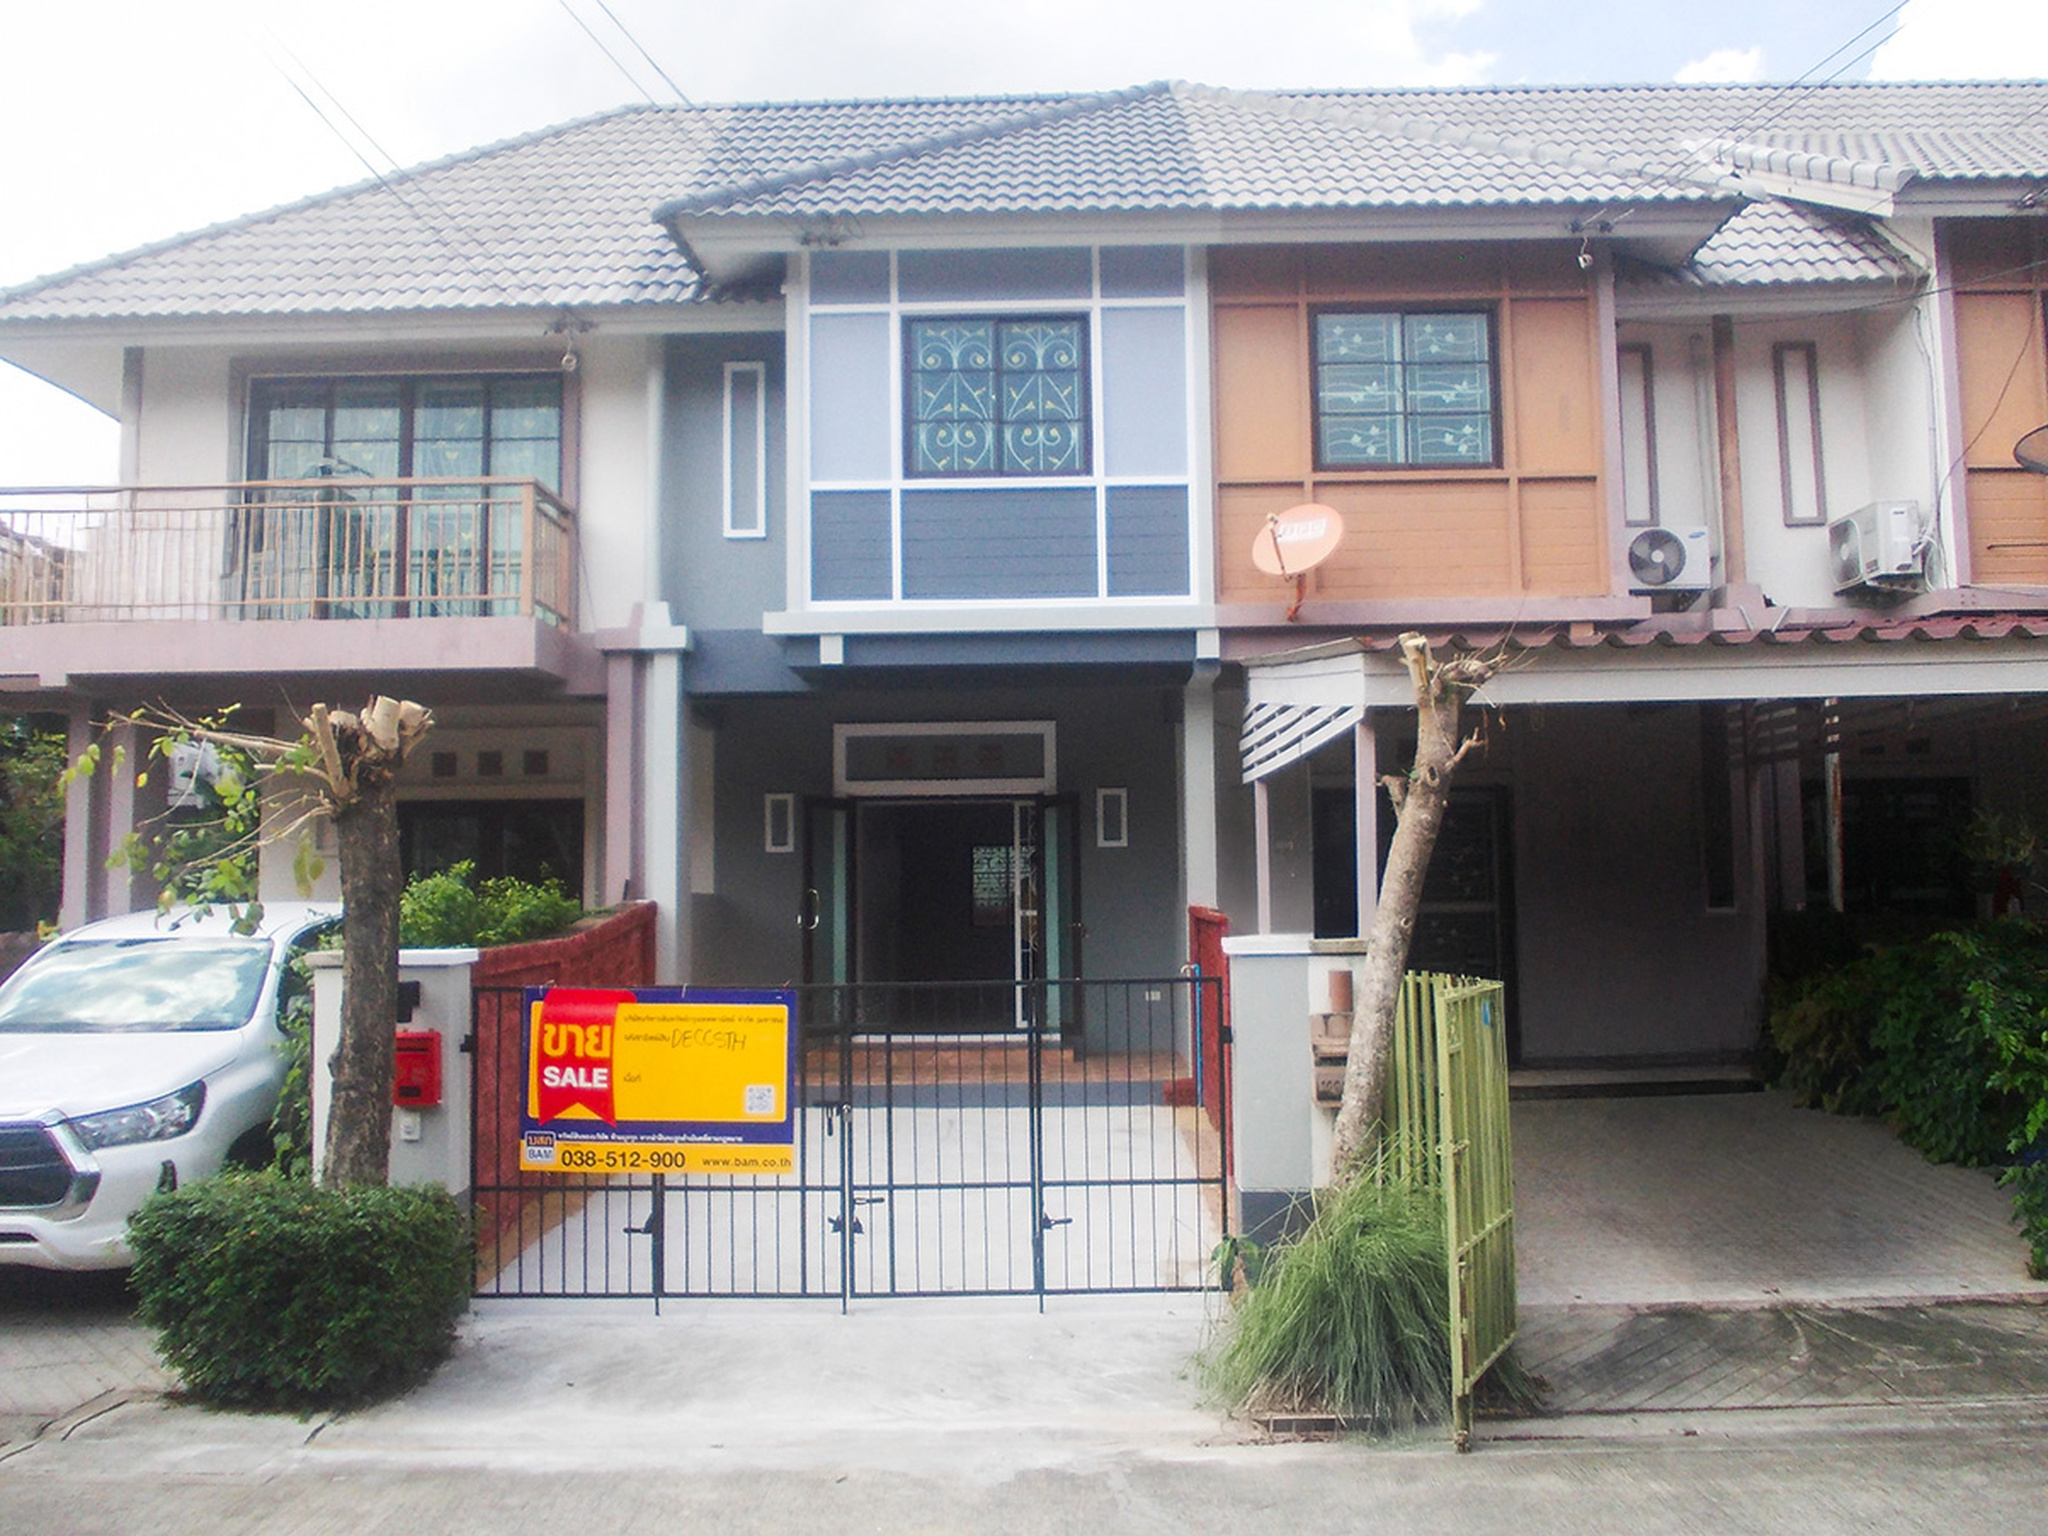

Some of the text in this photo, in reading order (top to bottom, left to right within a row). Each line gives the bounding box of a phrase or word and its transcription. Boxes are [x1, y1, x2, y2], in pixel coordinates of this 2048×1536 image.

[543, 1023, 610, 1058] ขาย
[543, 1066, 608, 1088] SALE
[528, 1149, 553, 1160] BAM
[561, 1150, 686, 1169] 038-512-900
[702, 1156, 791, 1168] www.bam.co.th
